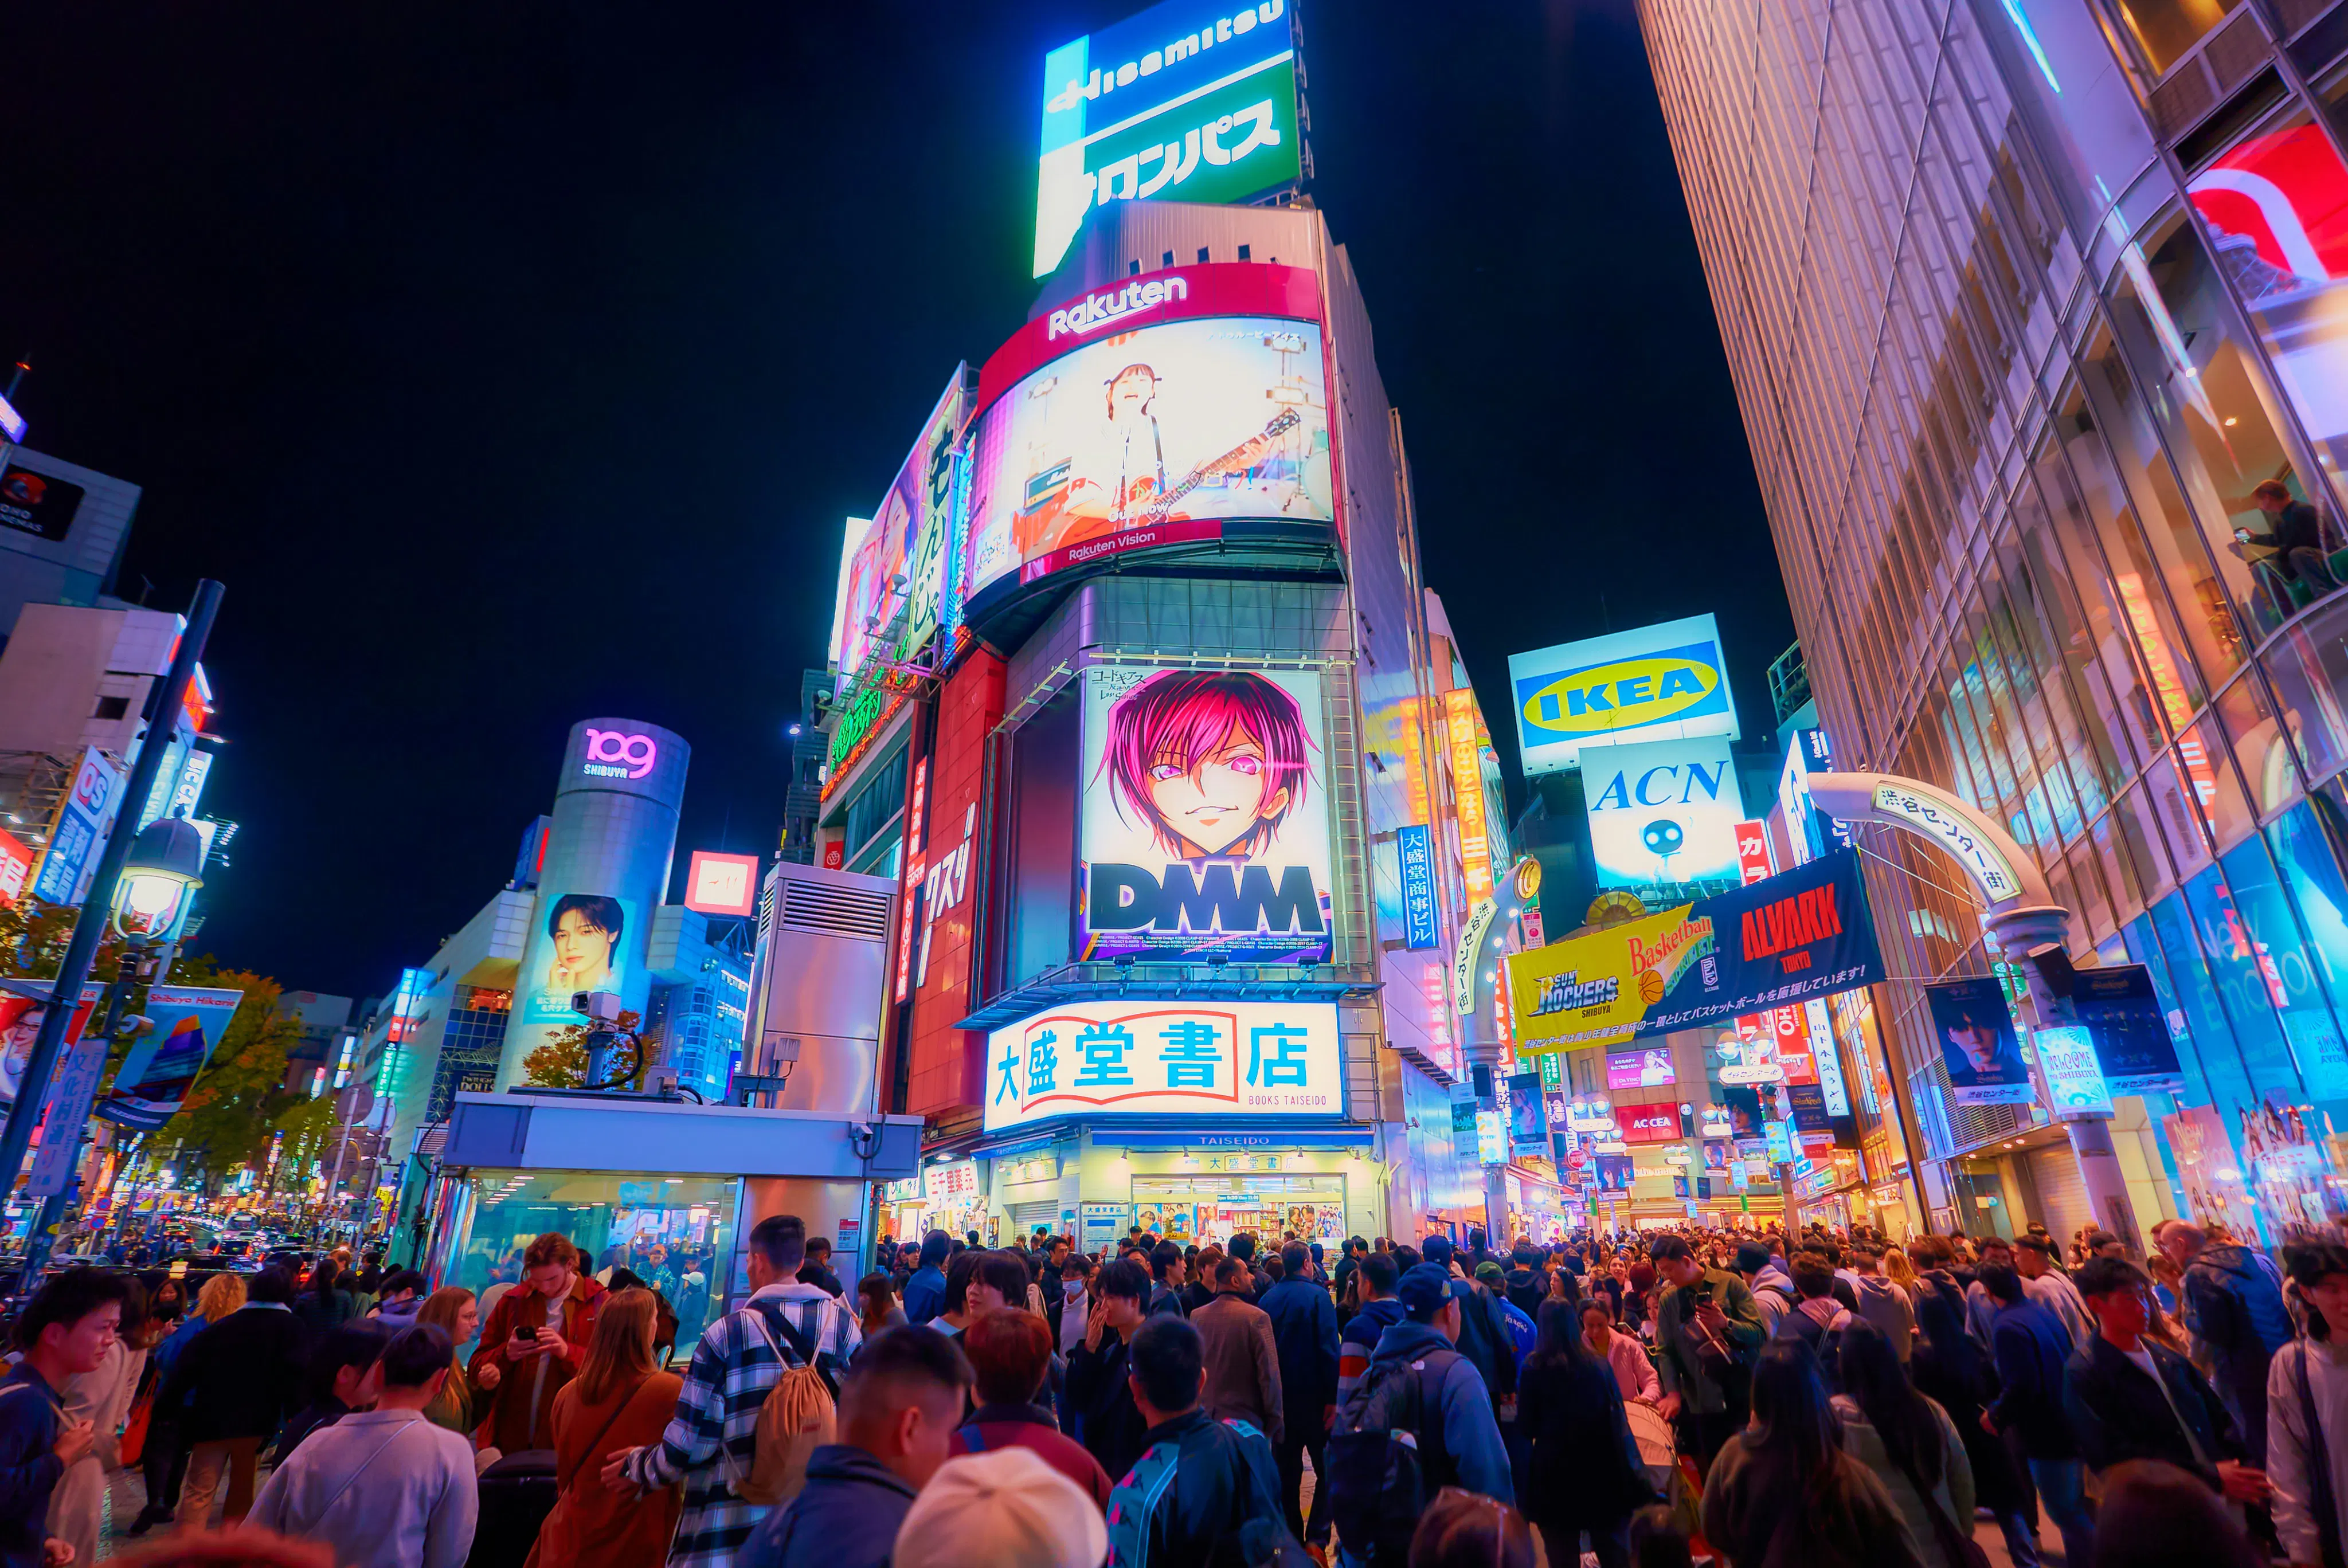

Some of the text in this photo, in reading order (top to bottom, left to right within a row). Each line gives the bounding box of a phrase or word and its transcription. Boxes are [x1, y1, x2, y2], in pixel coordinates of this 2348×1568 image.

[1048, 276, 1187, 340] Rakuten
[1138, 502, 1169, 517] Now
[1069, 531, 1156, 561] Rakuten Vision
[1092, 669, 1147, 685] コードギアス
[1540, 668, 1706, 722] IKEA
[183, 756, 205, 784] BIC
[583, 763, 628, 779] SHIBUYA
[586, 728, 656, 779] 109
[79, 764, 108, 810] OS
[1591, 760, 1729, 812] ACN
[1882, 790, 2006, 889] 渋谷センター街
[1089, 862, 1325, 934] DMM
[1405, 833, 1431, 943] 大盛堂商事ビル
[1742, 883, 1843, 962] ALVARK
[1458, 903, 1490, 1011] 渋谷センター街
[1627, 918, 1712, 977] Basketball
[1780, 951, 1811, 974] TOKYO
[1527, 975, 1619, 1017] ROCKERS
[1553, 970, 1578, 988] SUN
[150, 993, 236, 1007] Shibuya Hikarie
[1581, 1005, 1611, 1019] SHIBUYA
[995, 1021, 1308, 1107] 大盛堂書店
[2046, 1051, 2093, 1071] WELCOME
[2059, 1070, 2099, 1080] SHIBUYA
[1249, 1095, 1326, 1106] BOOKS TAISEIDO
[1199, 1136, 1269, 1145] TAISEIDO
